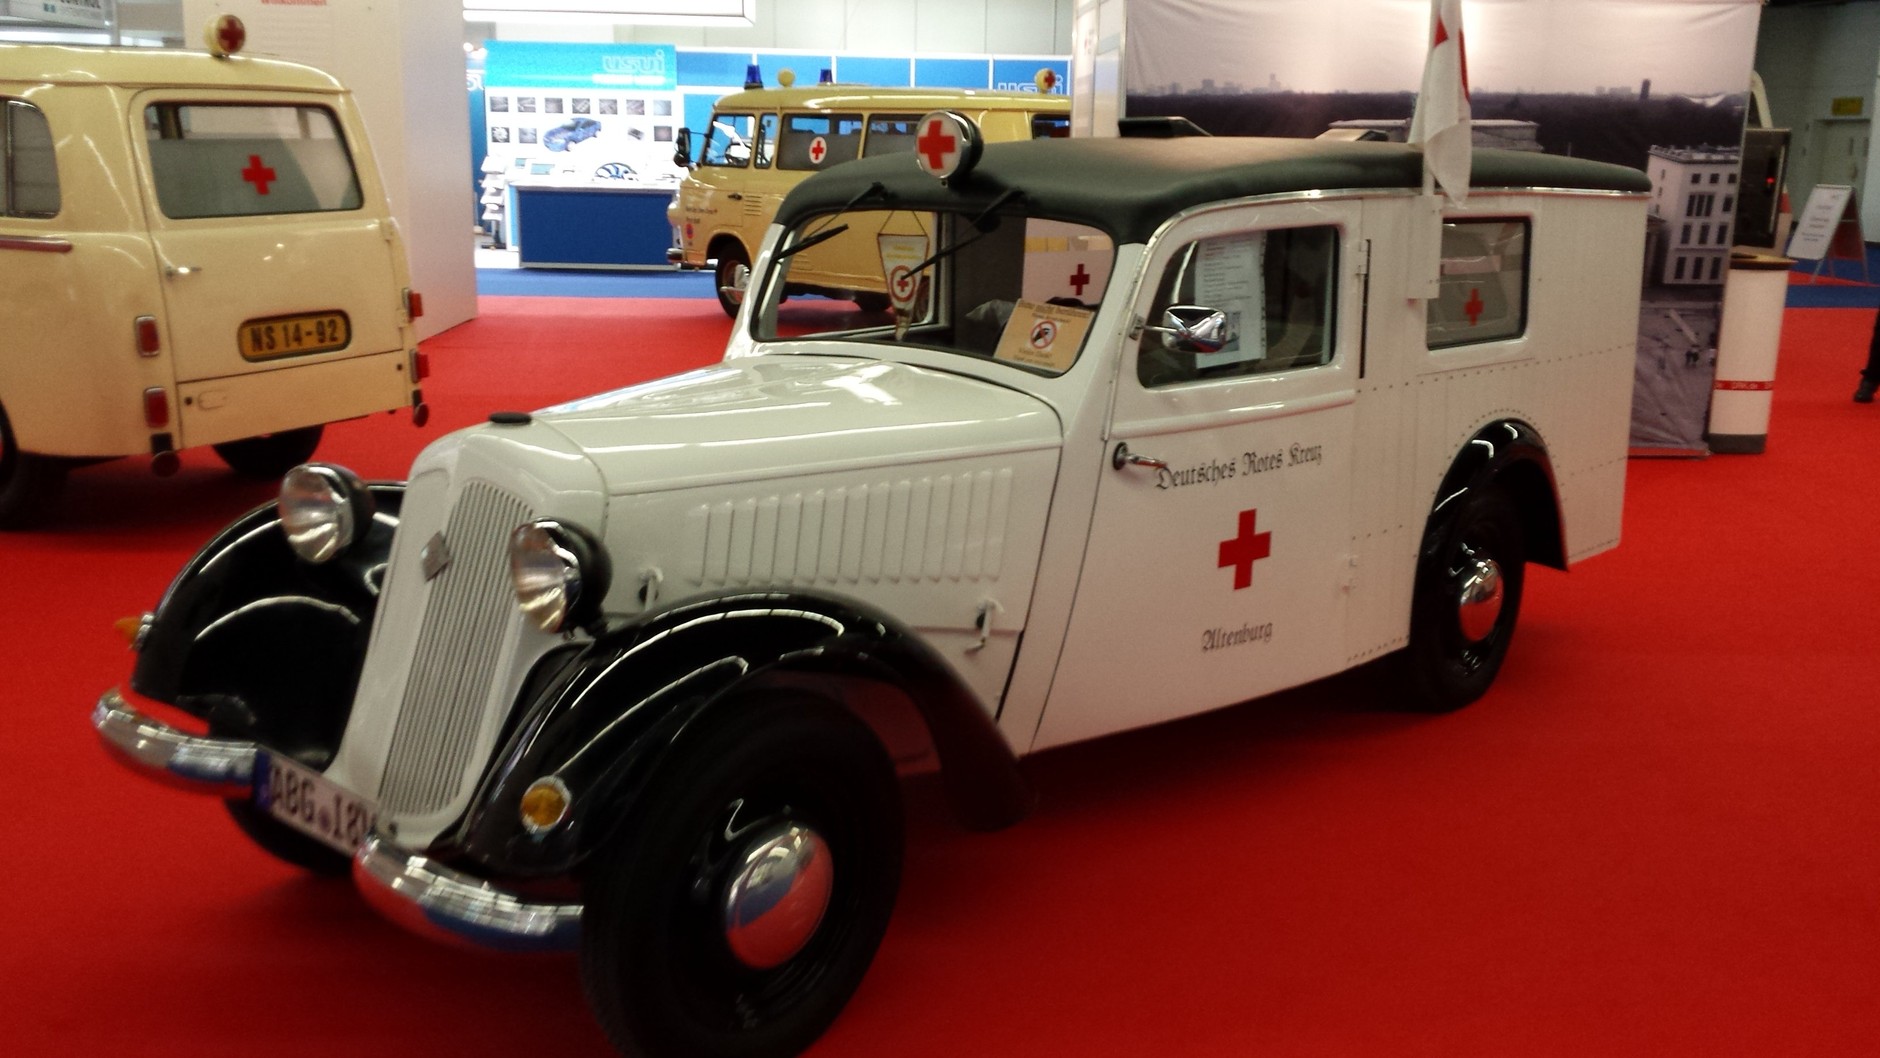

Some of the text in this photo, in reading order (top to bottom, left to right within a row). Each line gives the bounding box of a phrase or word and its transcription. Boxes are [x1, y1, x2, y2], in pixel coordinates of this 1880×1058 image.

[250, 318, 338, 352] NS 14-92
[1155, 441, 1323, 490] Deutsches Rotes Kreuz
[1202, 621, 1274, 652] Altenburg
